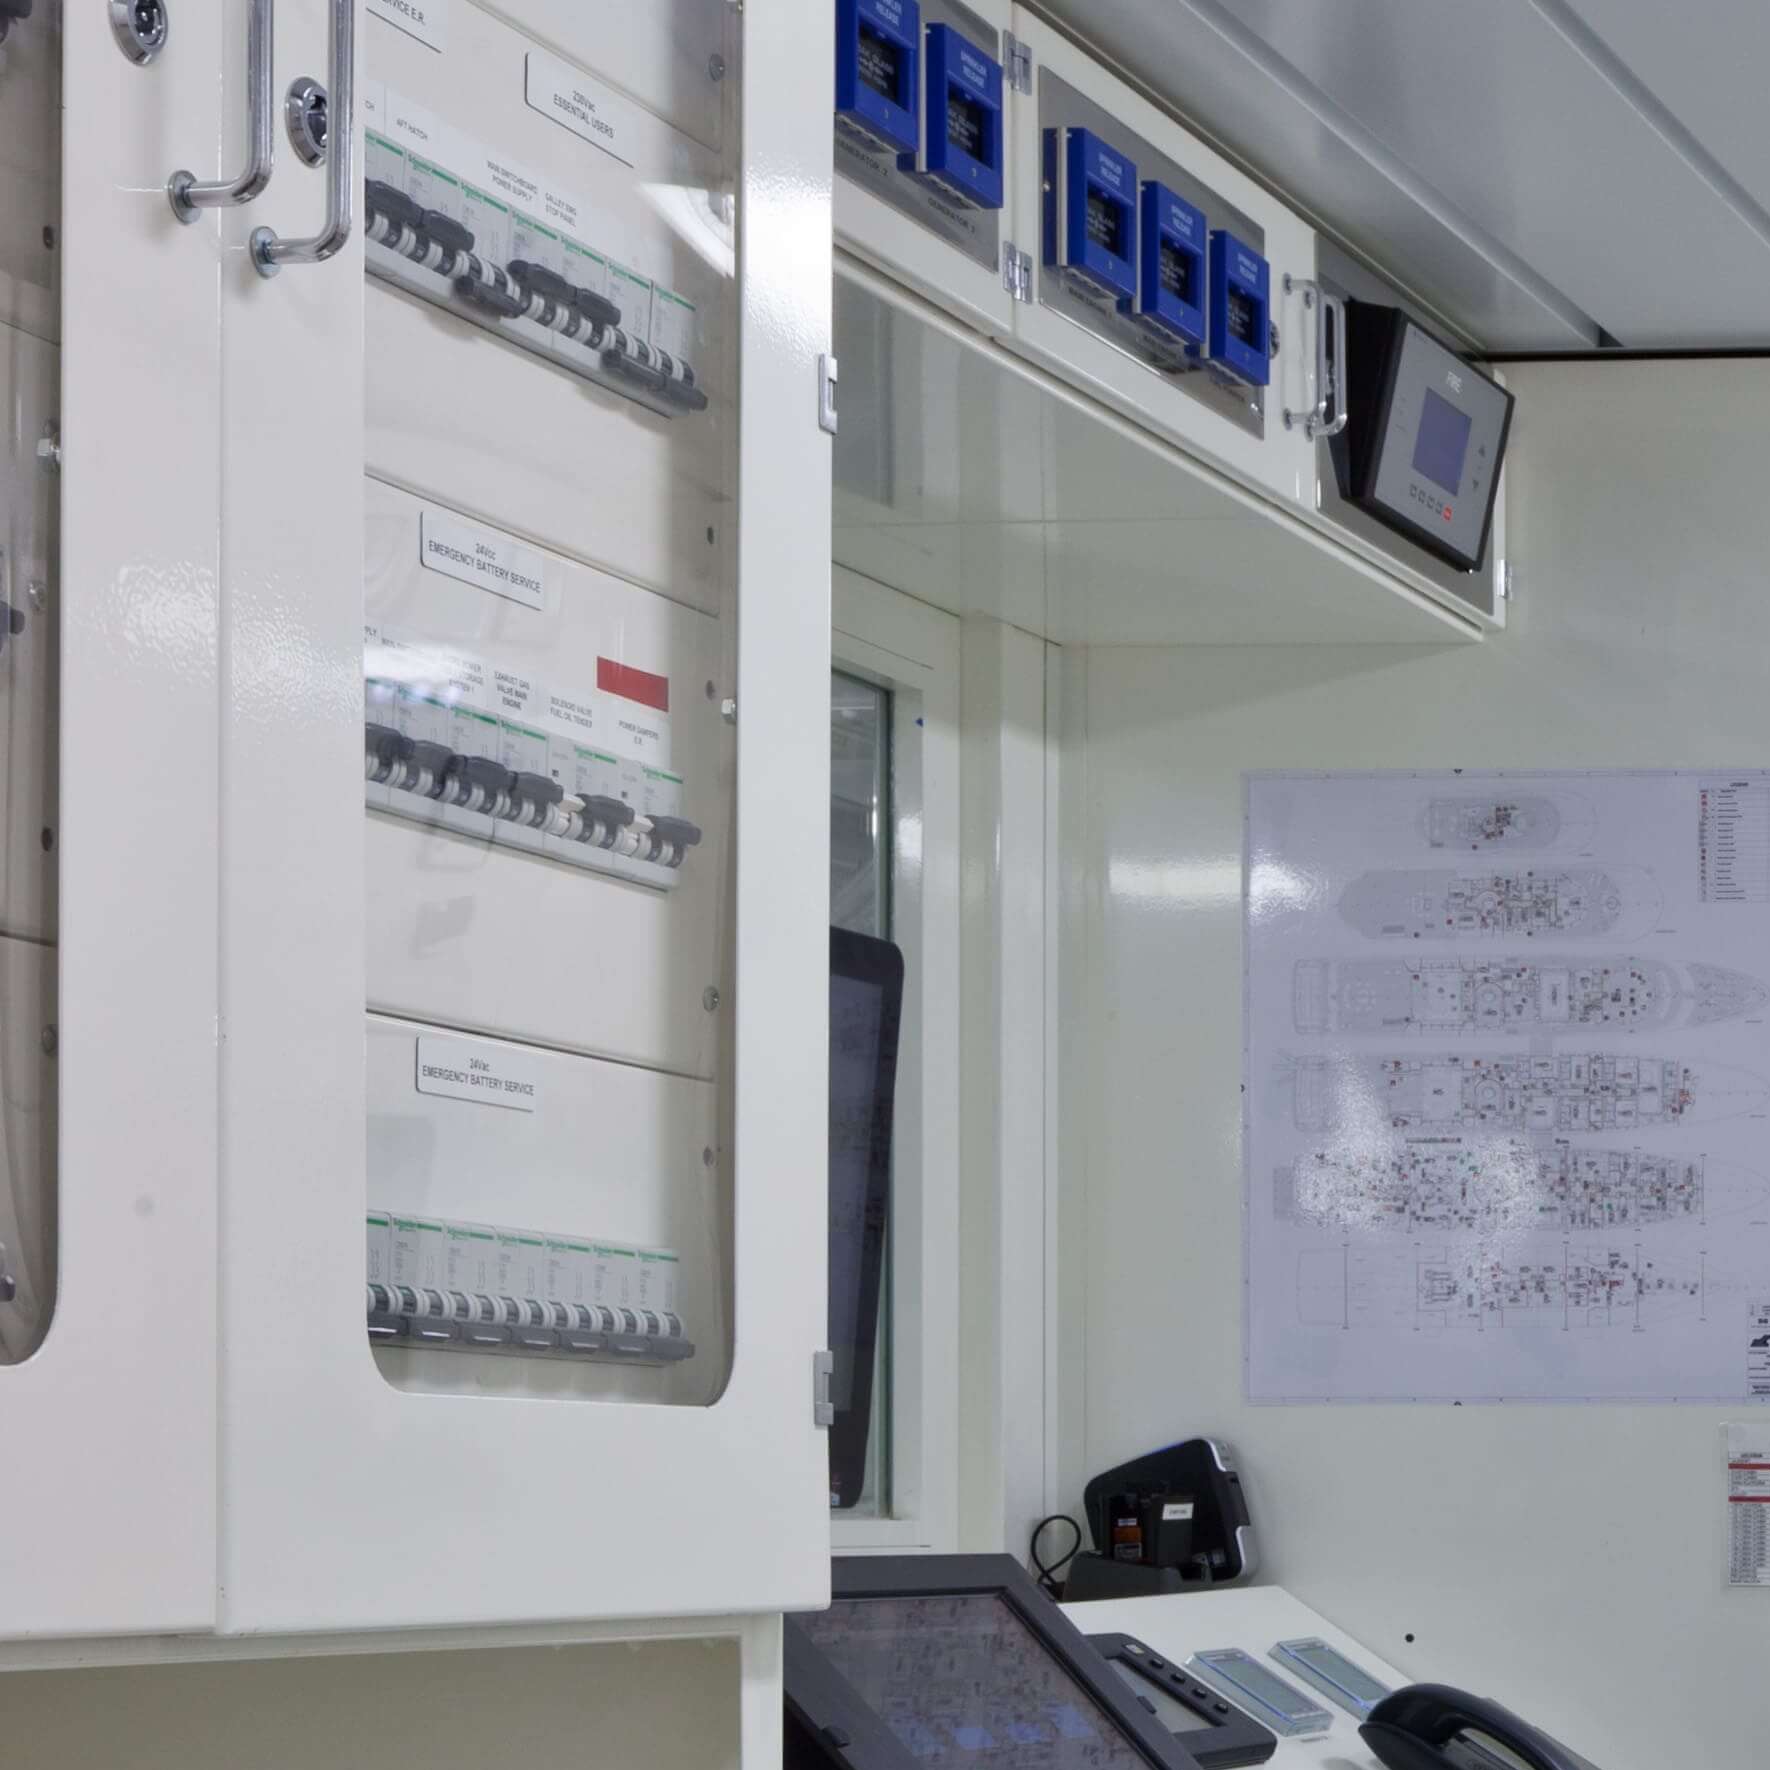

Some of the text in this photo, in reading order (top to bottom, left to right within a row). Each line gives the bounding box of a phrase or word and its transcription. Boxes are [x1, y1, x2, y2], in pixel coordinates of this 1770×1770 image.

[553, 94, 615, 139] ESSENTIAL USERS
[492, 174, 532, 202] POWER SUPPLY
[429, 540, 542, 594] EMERGENCY BATTERY SERVICE
[618, 719, 636, 733] POWER
[422, 1064, 535, 1097] EMERGENCY BATTERY SERVICE
